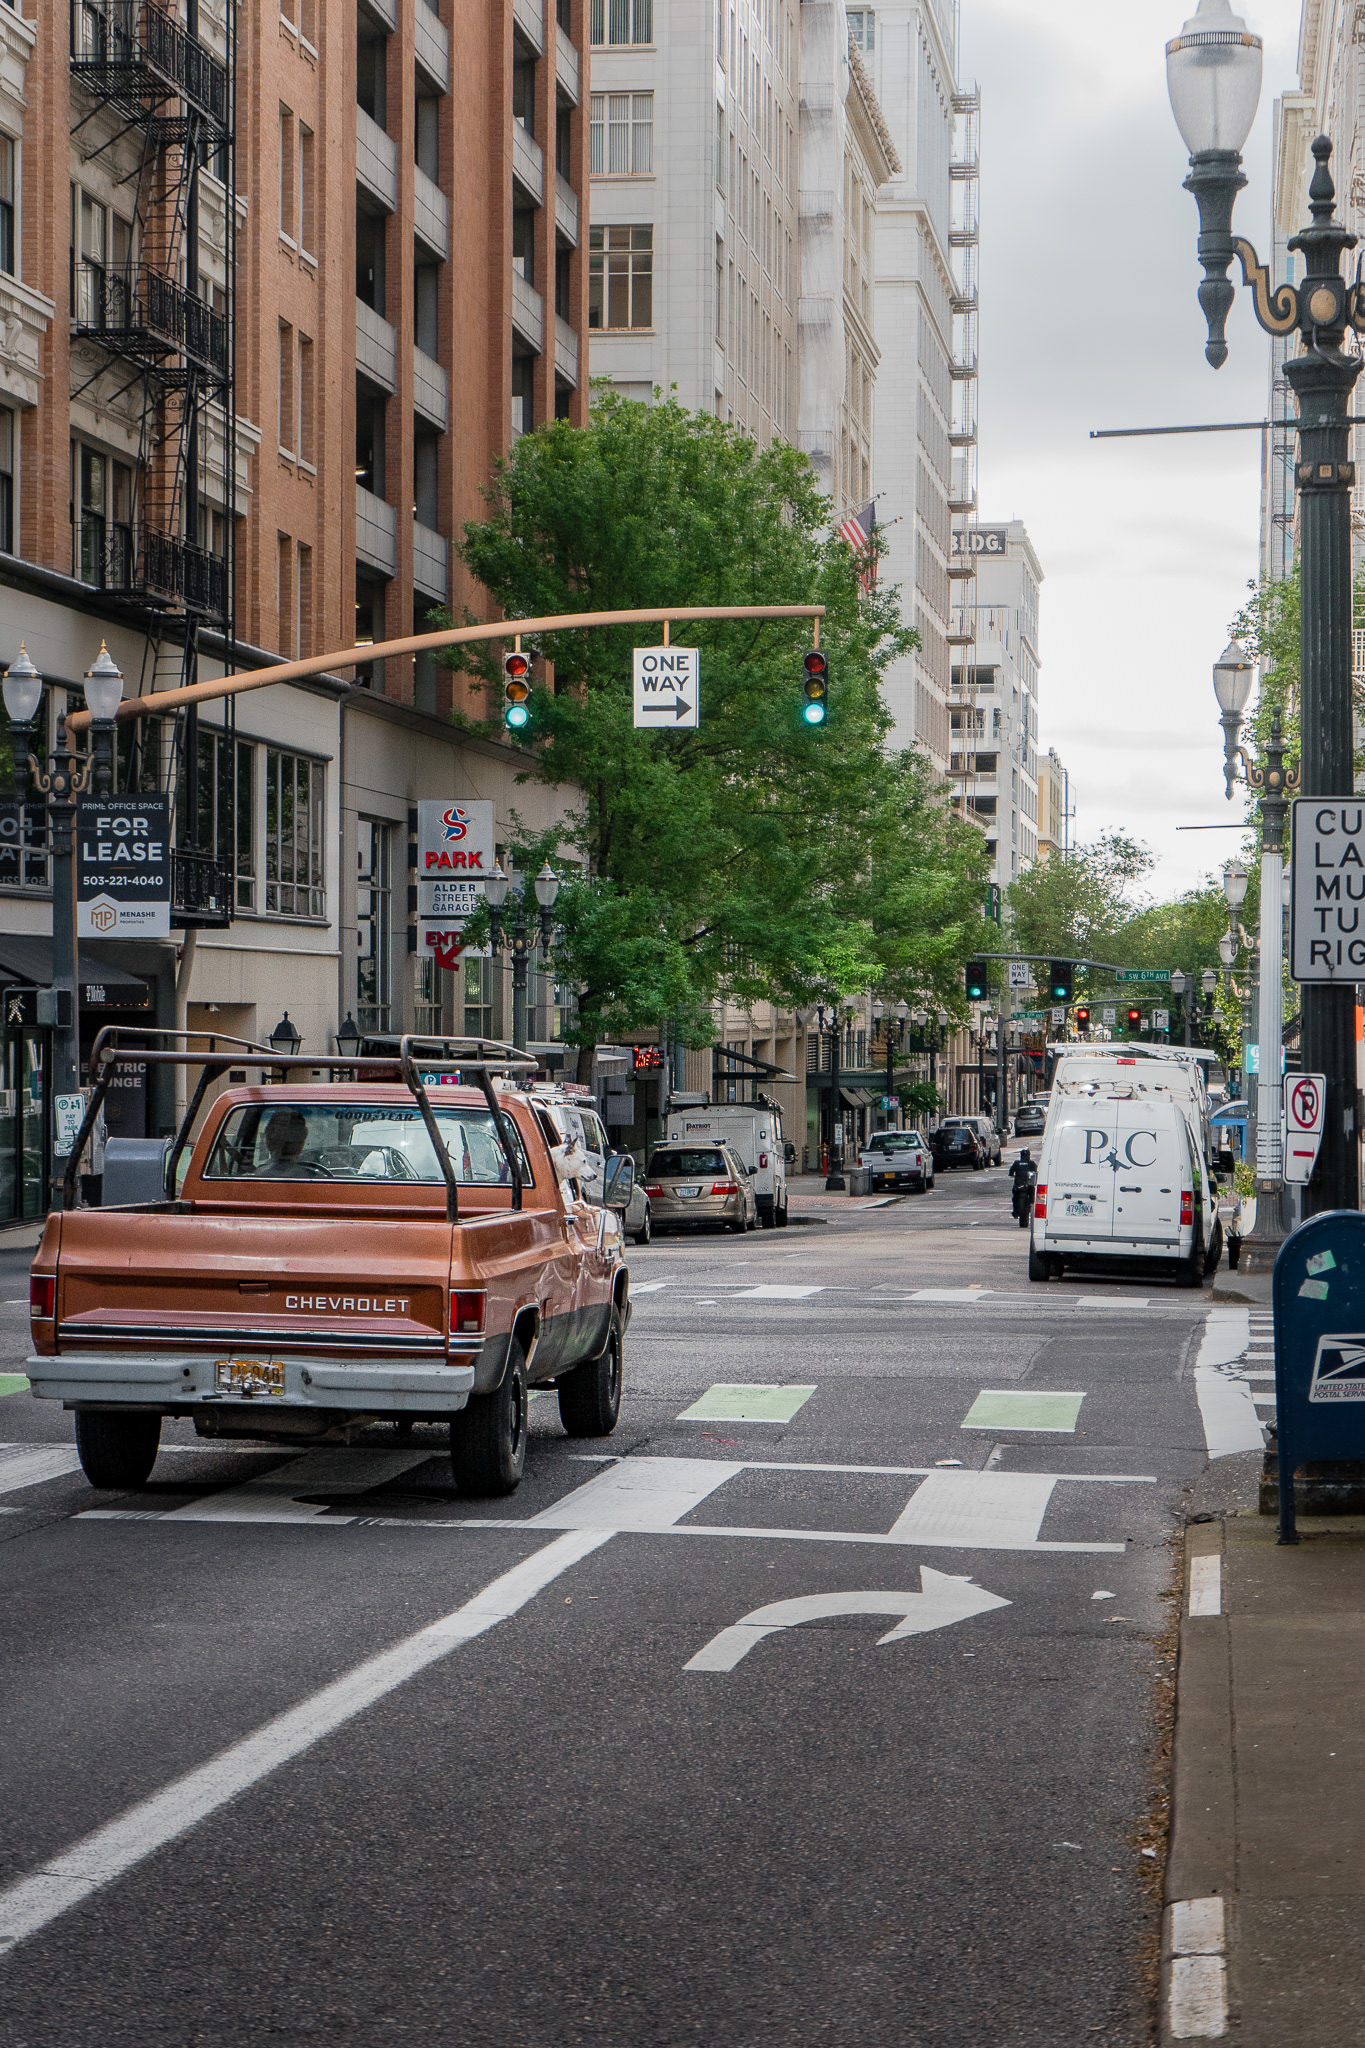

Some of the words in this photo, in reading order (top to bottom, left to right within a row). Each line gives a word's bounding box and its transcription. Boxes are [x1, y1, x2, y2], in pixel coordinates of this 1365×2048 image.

[642, 656, 690, 672] ONE
[642, 676, 690, 692] WAY
[96, 817, 149, 836] FOR
[83, 842, 163, 861] LEASE
[426, 851, 483, 868] PARK
[83, 876, 163, 886] 503-221-4040
[426, 931, 460, 946] ENT
[1066, 1204, 1078, 1214] 479
[286, 1296, 409, 1312] CHEVROLET
